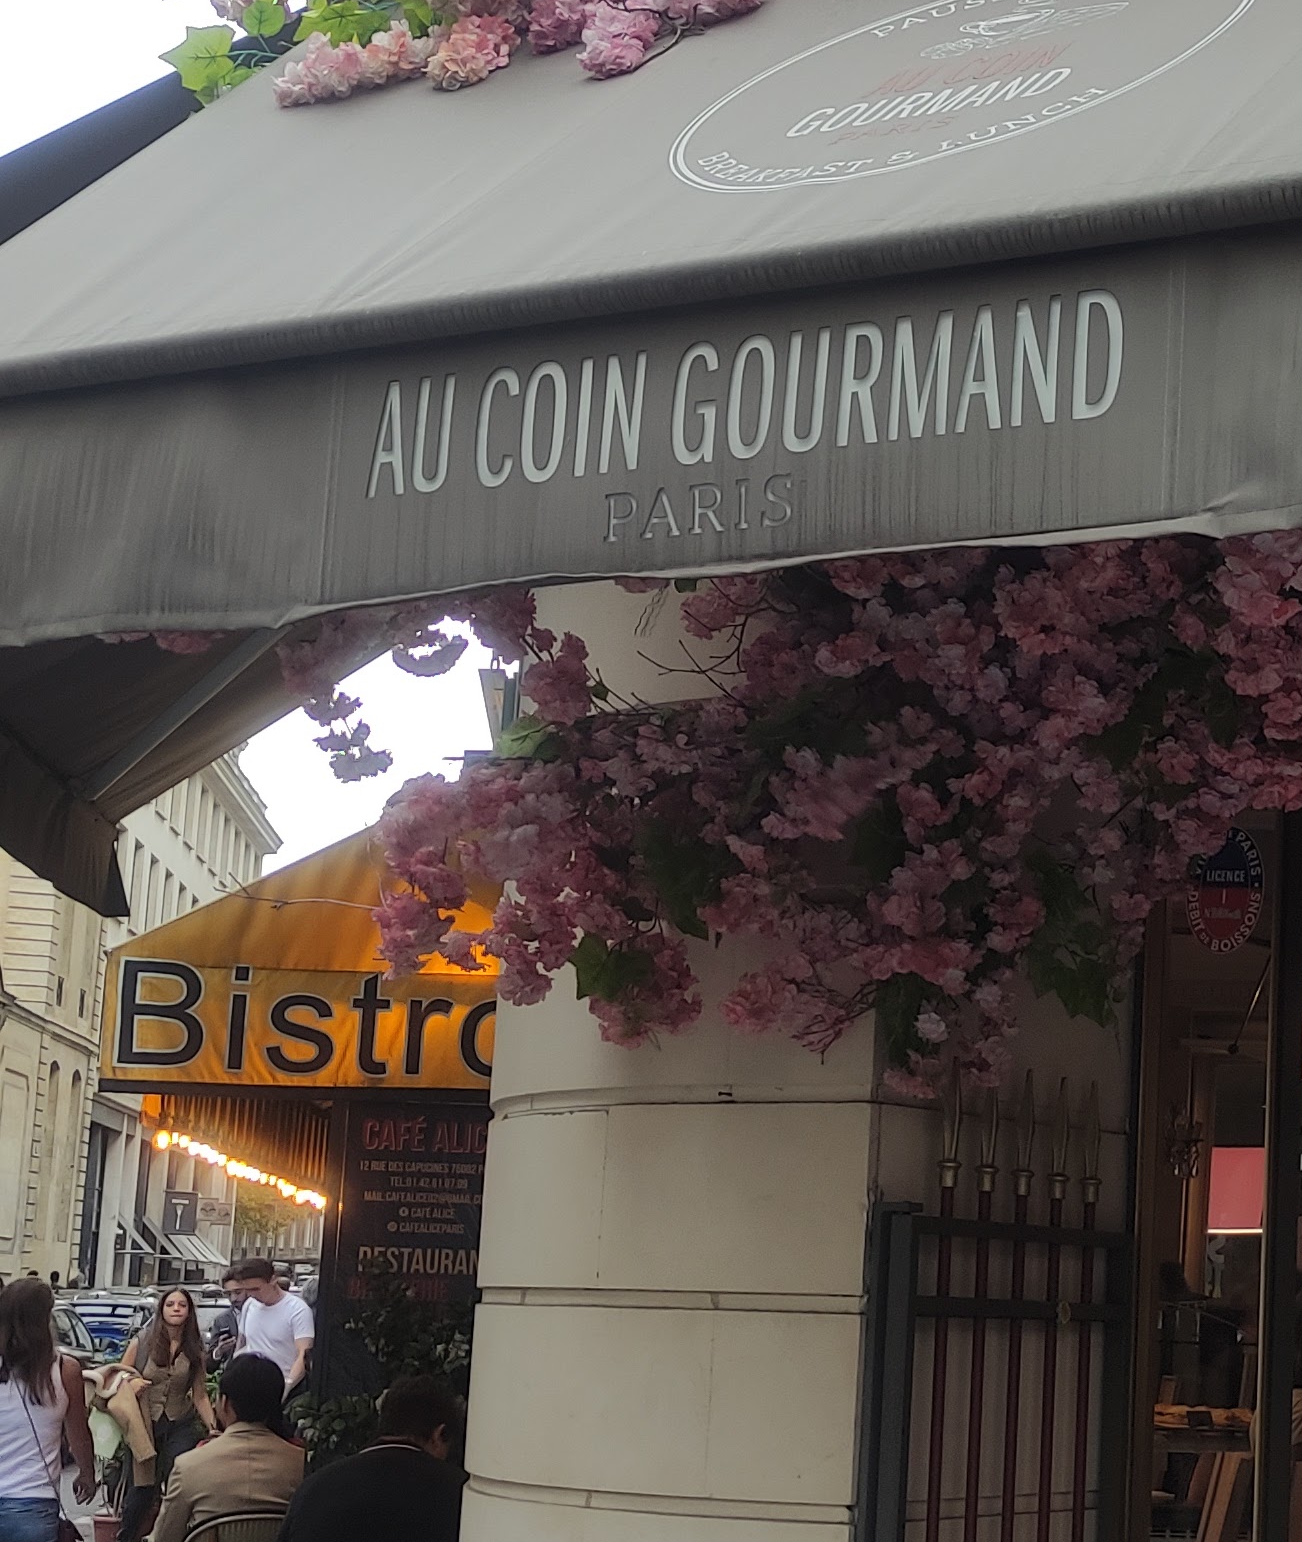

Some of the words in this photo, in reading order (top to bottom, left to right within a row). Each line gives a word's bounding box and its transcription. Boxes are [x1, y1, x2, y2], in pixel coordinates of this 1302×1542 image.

[860, 64, 942, 99] AU
[943, 41, 1074, 85] COIN
[786, 67, 1073, 138] GOURMAND
[827, 115, 959, 147] PARIS
[697, 151, 876, 185] BREAKFAST
[938, 87, 1109, 151] LUNCH
[366, 372, 458, 499] AU
[474, 351, 649, 489] COIN
[669, 288, 1125, 465] GOURMAND
[603, 472, 796, 543] PARIS
[1206, 869, 1246, 882] LICENCE
[1235, 831, 1262, 876] PARIS
[1188, 890, 1206, 931] DEBIT
[1211, 892, 1262, 951] BOISSONS
[363, 1115, 428, 1152] CAFÉ
